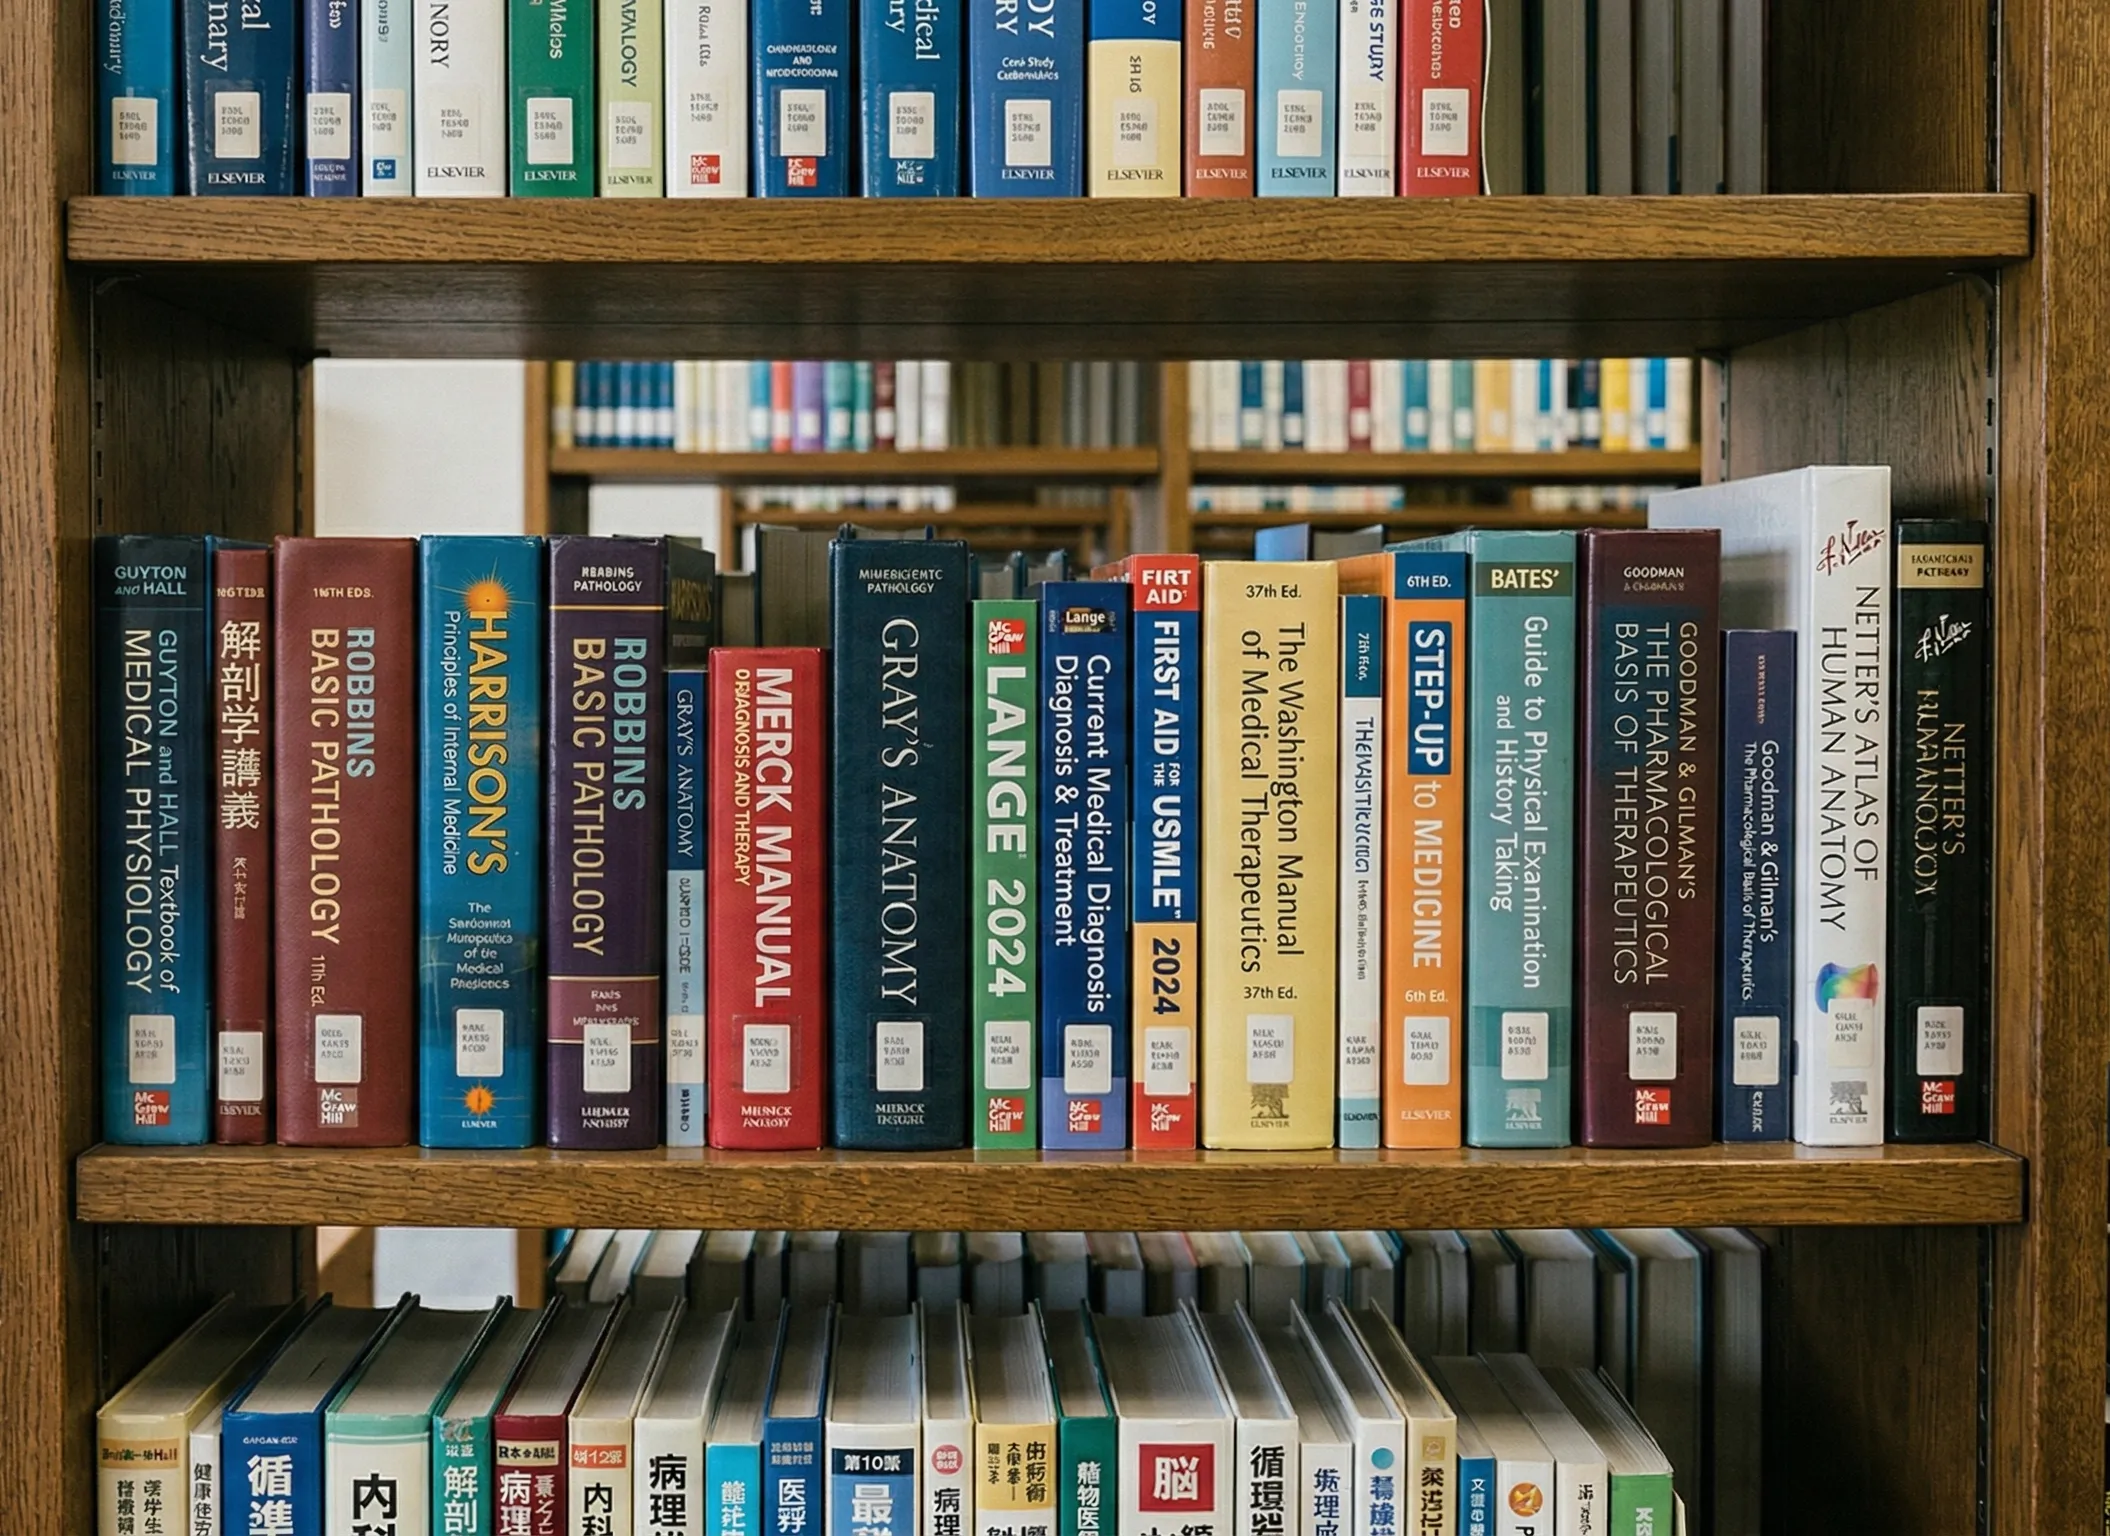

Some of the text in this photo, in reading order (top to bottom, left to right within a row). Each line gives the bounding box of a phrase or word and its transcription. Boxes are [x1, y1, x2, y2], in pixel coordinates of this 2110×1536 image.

[430, 3, 450, 69] NORY
[112, 171, 156, 181] ELSEVIER
[207, 173, 266, 185] ELSEVIER
[427, 167, 485, 179] ELSEVIER
[524, 170, 577, 181] ELSEVIER
[1002, 169, 1055, 181] ELSEVIER
[1107, 169, 1164, 181] ELSEVIER
[1196, 169, 1248, 180] ELSEVIER
[1271, 167, 1327, 179] ELSEVIER
[1344, 168, 1391, 180] ELSEVIER
[1416, 167, 1471, 179] ELSEVIER
[114, 566, 187, 580] GUYTON
[143, 582, 187, 596] HALL
[573, 580, 643, 593] PATHOLOGY
[1142, 569, 1192, 586] FIRT
[1245, 584, 1302, 599] 37th Ed.
[1406, 575, 1452, 588] 6TH ED.
[1490, 568, 1560, 589] BATES'
[1623, 566, 1685, 578] GOODMAN
[988, 621, 1012, 633] Mc
[1065, 610, 1106, 627] Lange
[1524, 615, 1548, 688] Guide
[311, 628, 340, 729] BASIC
[346, 627, 376, 778] ROBBINS
[1153, 620, 1181, 756] FIRST AID
[1524, 696, 1546, 721] to
[220, 620, 262, 830] 解剖学講義
[440, 610, 462, 876] Principles of Internal Medicine
[613, 637, 648, 811] ROBBINS
[1744, 741, 1757, 766] The
[1853, 586, 1880, 881] NETTER'S ATLAS OF
[1153, 761, 1166, 787] THE
[1168, 761, 1181, 787] FOR
[1270, 622, 1306, 955] The Washington Manual
[1517, 730, 1548, 832] Physical
[1677, 622, 1698, 900] GOODMAN & GILMAN'S
[1760, 739, 1779, 831] Goodman
[1819, 627, 1848, 931] HUMAN ANATOMY
[1942, 722, 1966, 855] NETTER'S
[124, 630, 153, 995] MEDICAL PHYSIOLOGY
[158, 630, 181, 994] GUYTON and HALL Textbook of
[572, 638, 607, 956] BASIC PATHOLOGY
[676, 764, 694, 858] ANATOMY
[735, 772, 751, 887] AND THERAPY
[881, 617, 919, 1007] GRAY'S ANATOMY
[1049, 655, 1079, 947] Diagnosis & Treatment
[1233, 630, 1270, 973] of Medical Therapeutics
[1412, 628, 1446, 968] STEP-UP to MEDICINE
[1489, 694, 1518, 913] and History Taking
[1613, 623, 1639, 985] BASIS OF THERAPEUTICS
[1645, 622, 1670, 985] THE PHARMACOLOGICAL
[311, 741, 341, 945] PATHOLOGY
[754, 668, 794, 1008] MERCK MANUAL
[987, 666, 1027, 998] LANGE 2024
[1080, 654, 1112, 1013] Current Medical Diagnosis
[1760, 840, 1779, 859] &
[468, 902, 492, 913] The
[1760, 863, 1780, 943] Gilman's
[1152, 937, 1181, 1015] 2024
[1243, 986, 1298, 1000] 37th Ed.
[1405, 990, 1448, 1003] 6th Ed.
[321, 1089, 342, 1101] Mc
[989, 1098, 1012, 1110] Mc
[1400, 1110, 1452, 1121] ELSEVIER
[1922, 1081, 1944, 1093] Mc
[649, 1453, 688, 1536] 病理
[1153, 1455, 1200, 1501] 脳
